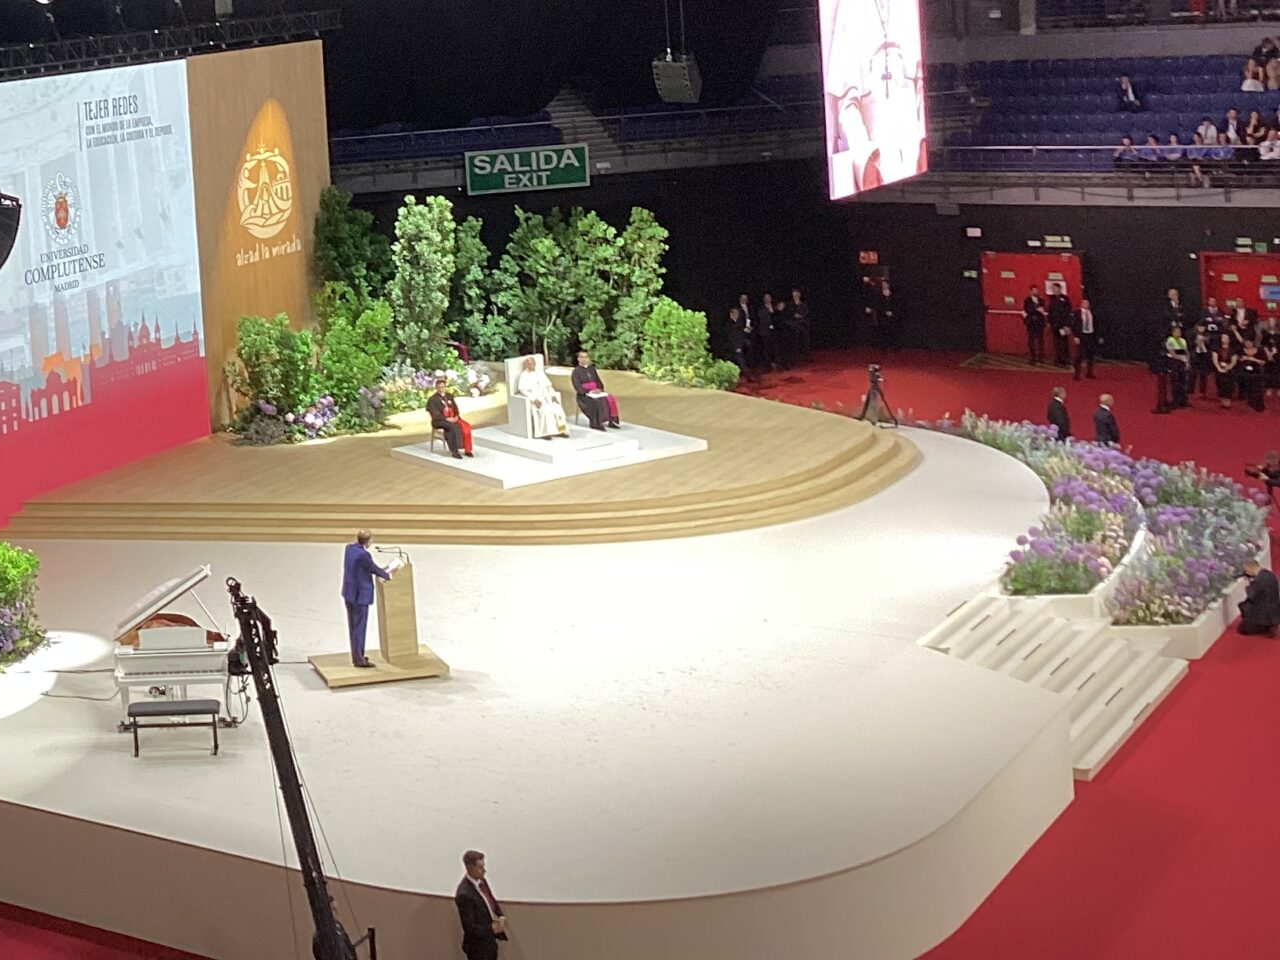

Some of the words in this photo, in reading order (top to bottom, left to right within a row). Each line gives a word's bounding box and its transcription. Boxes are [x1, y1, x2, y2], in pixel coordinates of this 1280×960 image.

[83, 99, 110, 121] TEJER
[112, 94, 139, 117] REDES
[473, 149, 580, 175] SALIDA
[504, 171, 551, 188] EXIT
[39, 243, 89, 264] UNIVERSIDAD
[235, 243, 259, 267] alzad
[261, 243, 270, 260] la
[272, 234, 302, 258] mirada
[24, 253, 106, 286] COMPLUTENSE
[54, 279, 80, 292] MADRID
